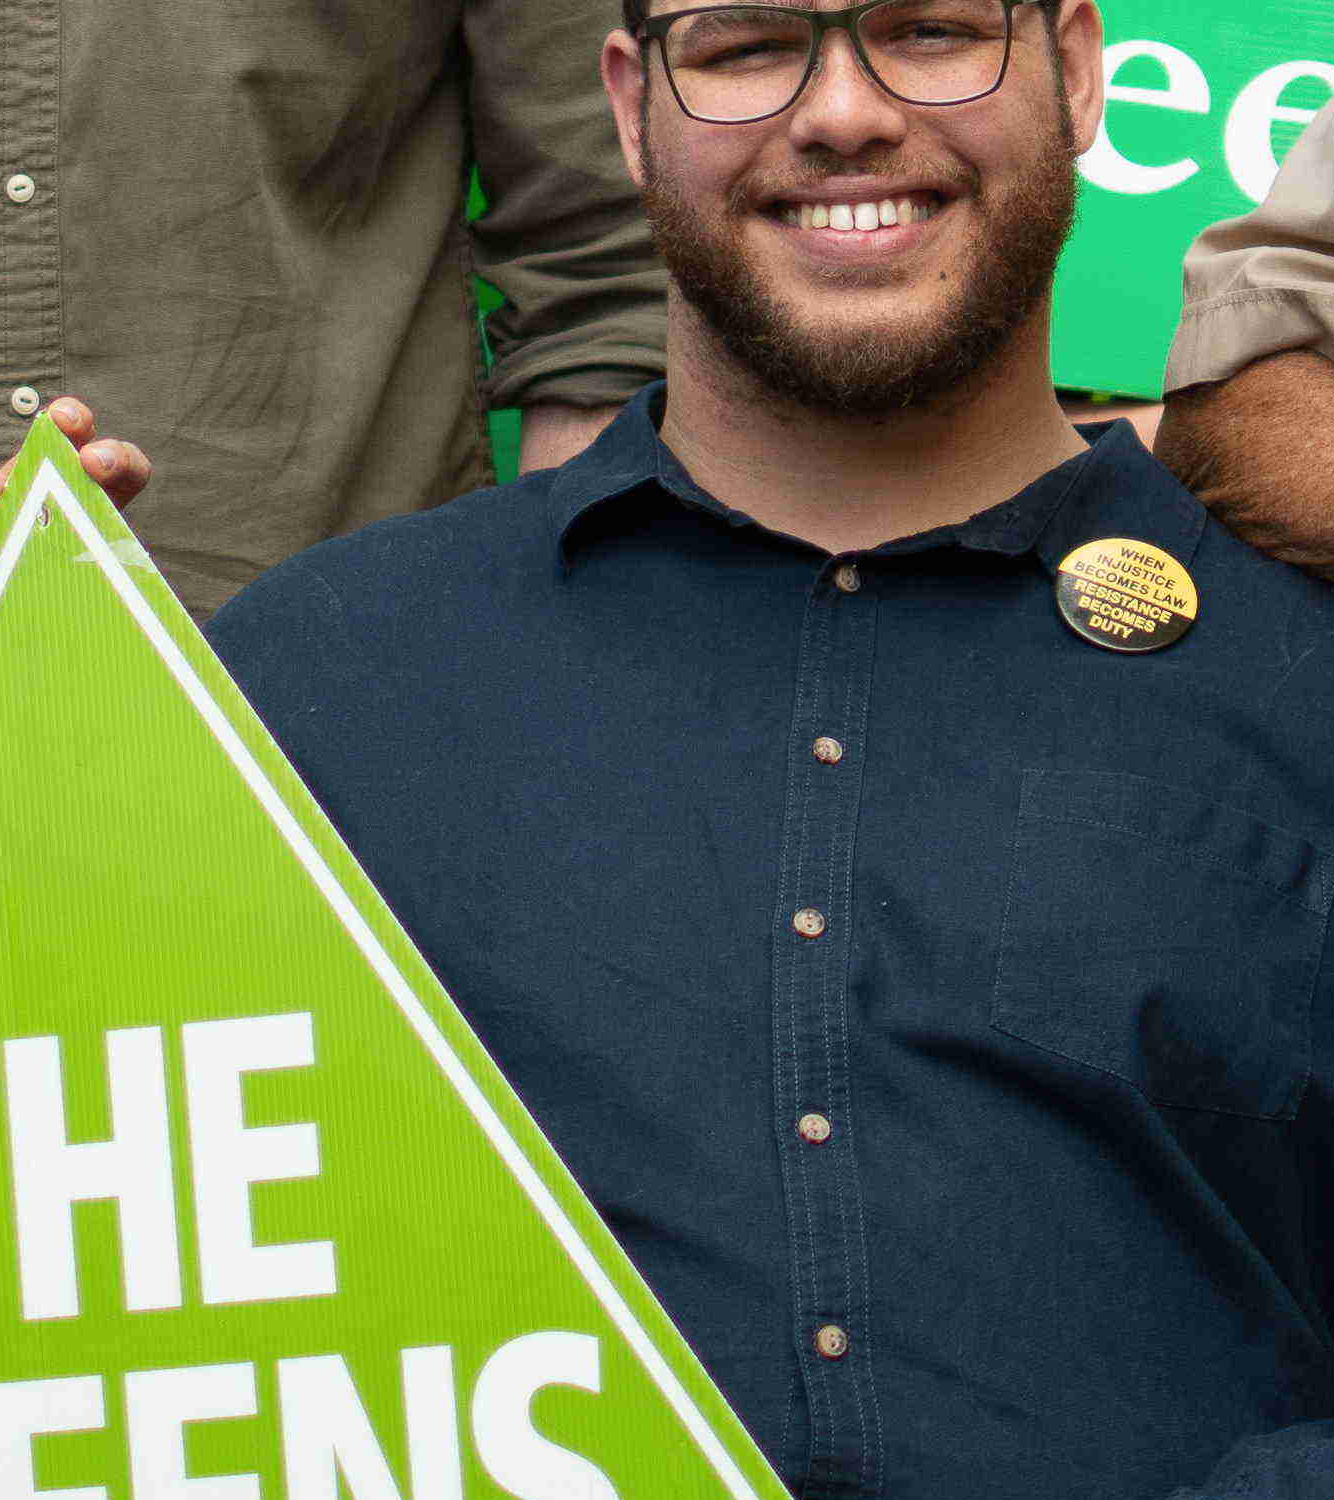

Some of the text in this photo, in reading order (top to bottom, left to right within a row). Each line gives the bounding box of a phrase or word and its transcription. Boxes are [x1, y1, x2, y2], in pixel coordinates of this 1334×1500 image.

[1097, 554, 1177, 591] INJUSTICE
[1120, 546, 1165, 571] WHEN
[1073, 578, 1173, 625] RESISTANCE
[1074, 560, 1188, 609] BECOMES LAW
[1078, 594, 1156, 633] BECOMES
[1088, 614, 1134, 639] DUTY
